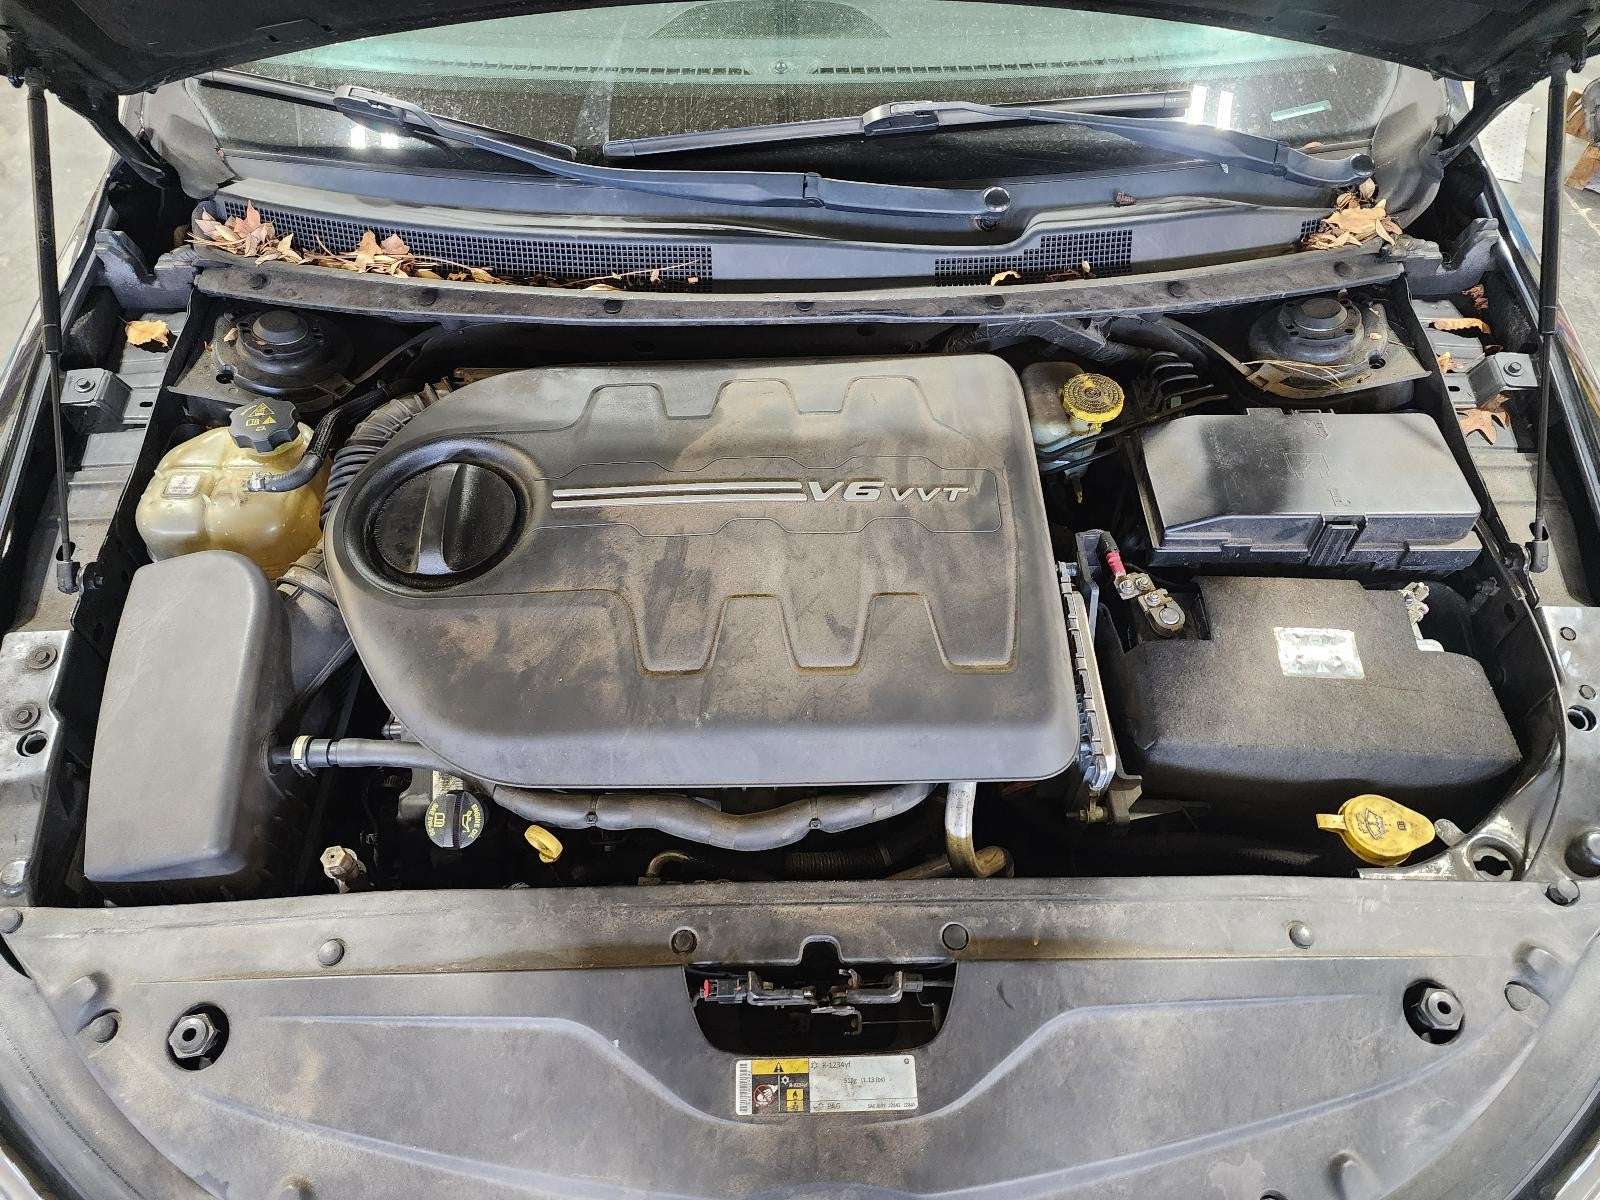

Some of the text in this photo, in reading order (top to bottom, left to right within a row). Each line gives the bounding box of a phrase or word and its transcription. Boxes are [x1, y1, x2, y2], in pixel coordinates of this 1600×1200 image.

[808, 481, 969, 502] V6 VVT
[468, 804, 481, 838] ENGINE OIL
[822, 1061, 851, 1070] R-1234yf
